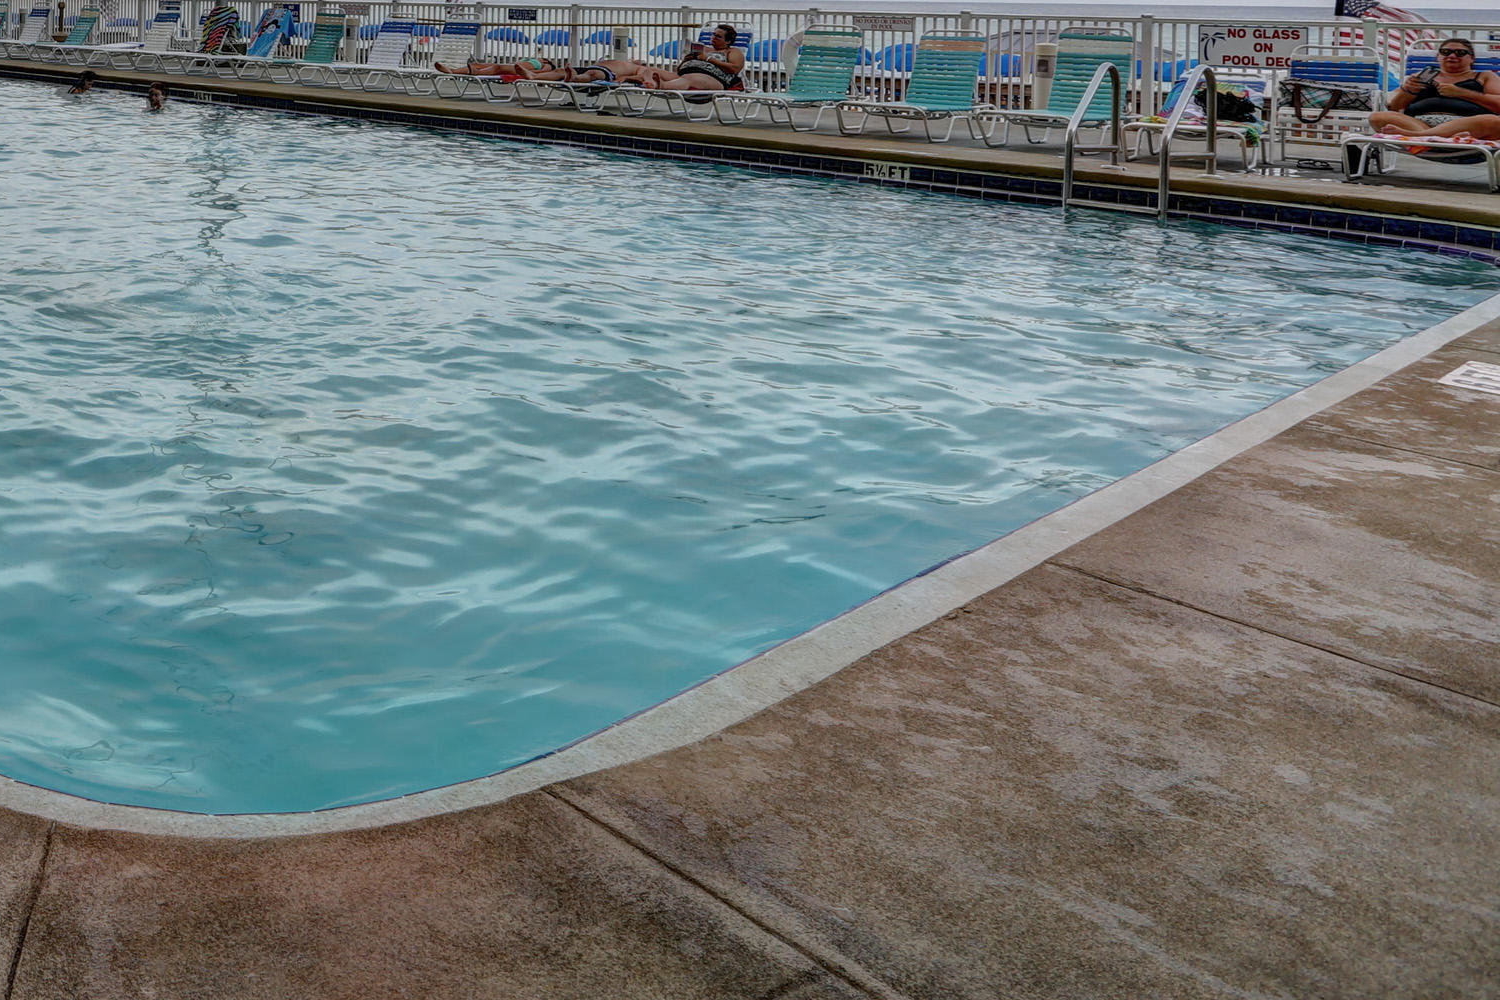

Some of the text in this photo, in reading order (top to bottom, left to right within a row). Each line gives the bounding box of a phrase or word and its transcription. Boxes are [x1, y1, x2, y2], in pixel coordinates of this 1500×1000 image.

[1227, 28, 1301, 40] NO GLASS
[1253, 42, 1273, 53] ON
[1222, 55, 1293, 67] POOL DEC
[888, 165, 908, 179] FT
